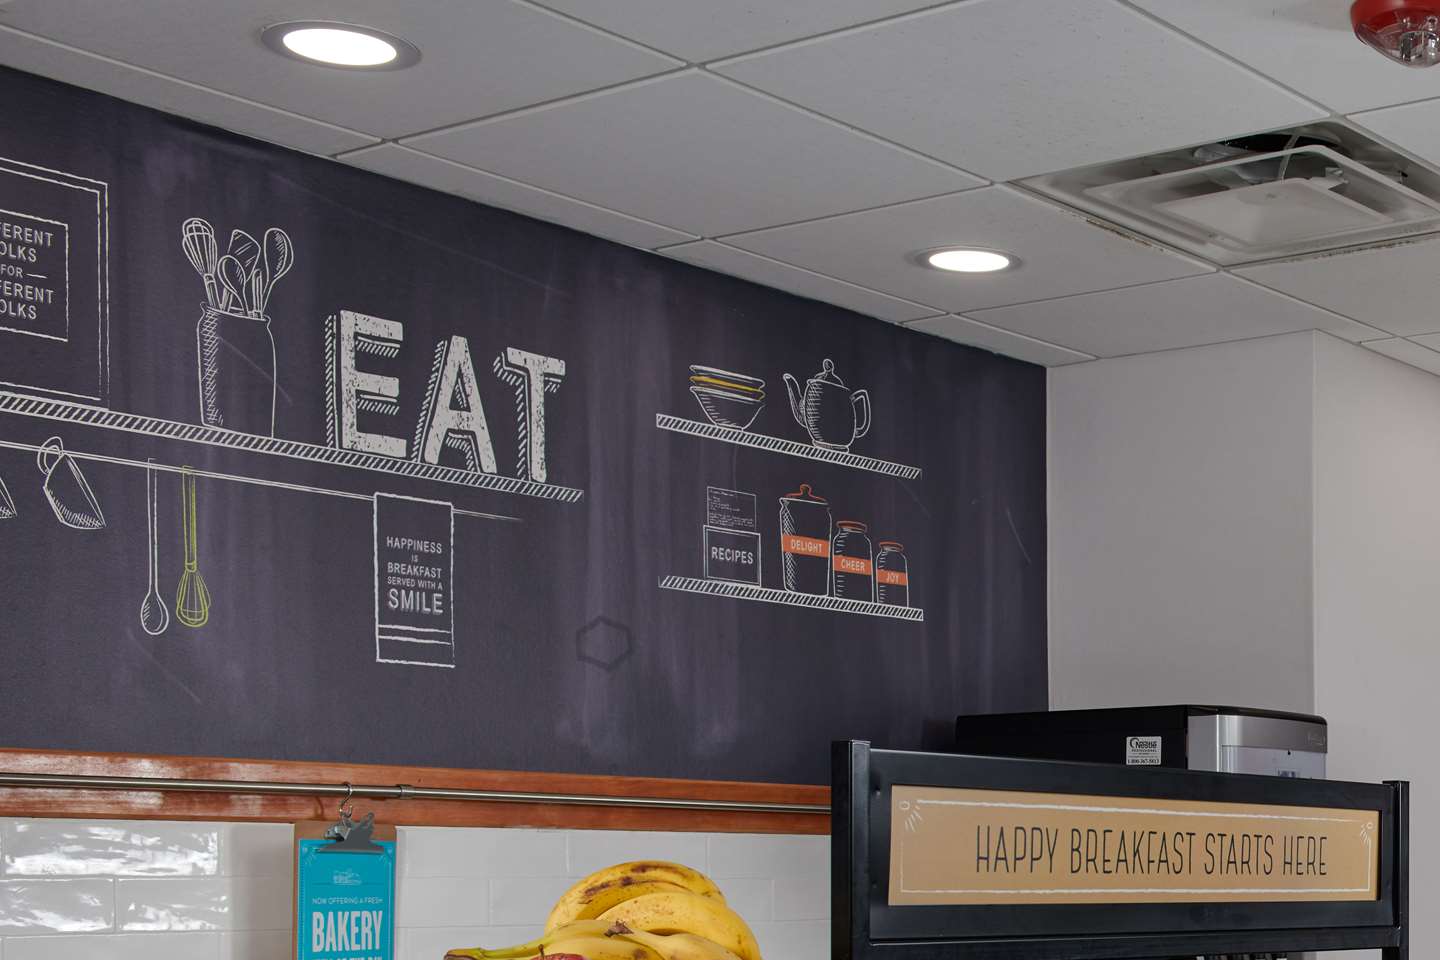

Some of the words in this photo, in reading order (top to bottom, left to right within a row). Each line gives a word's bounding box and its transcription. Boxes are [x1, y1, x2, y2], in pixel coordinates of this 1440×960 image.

[0, 222, 53, 247] ERENT
[0, 264, 23, 278] FOR
[0, 280, 54, 304] ERENT
[325, 310, 566, 483] EAT
[386, 536, 442, 554] HAPPINESS
[791, 540, 823, 553] DELIGHT
[411, 554, 419, 563] IS
[711, 546, 754, 565] RECIPES
[387, 562, 442, 578] BREAKFAST
[840, 559, 866, 572] CHEER
[387, 576, 416, 588] SERVED
[417, 580, 436, 591] WITH
[437, 582, 443, 591] A
[885, 570, 900, 583] JOY
[388, 588, 444, 615] SMILE
[976, 825, 1059, 873] HAPPY
[1070, 828, 1196, 875] BREAKFAST
[1204, 832, 1274, 875] STARTS
[1283, 836, 1328, 876] HERE
[312, 910, 383, 952] BAKERY
